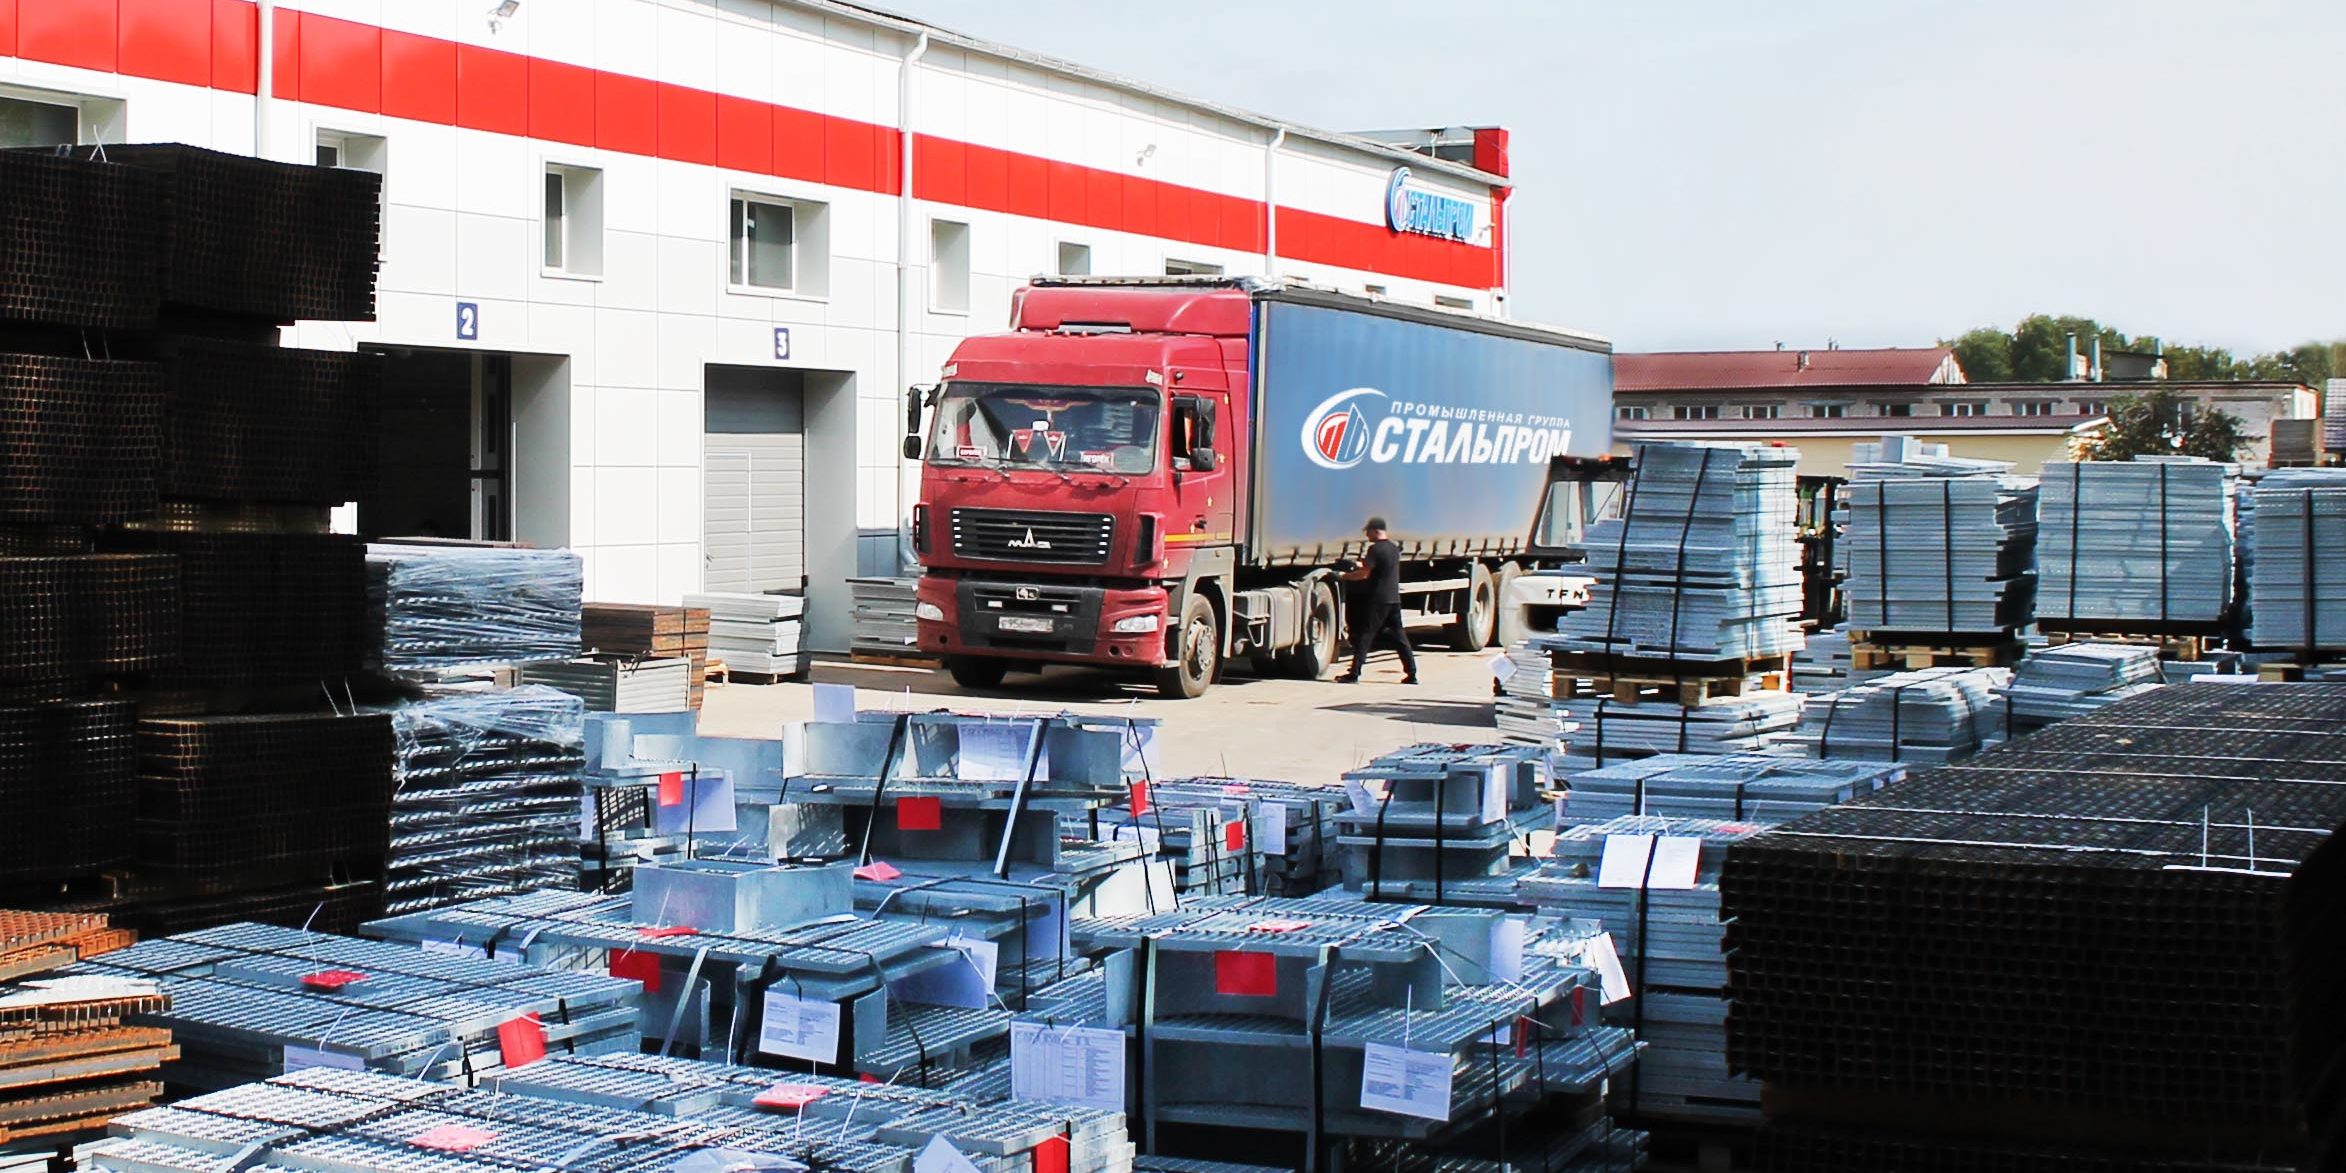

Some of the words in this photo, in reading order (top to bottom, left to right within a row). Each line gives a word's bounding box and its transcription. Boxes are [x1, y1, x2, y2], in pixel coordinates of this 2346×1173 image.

[461, 307, 474, 336] 2
[777, 331, 787, 357] 3
[1390, 401, 1523, 425] ПРОМЫШЛЕННАЯ
[1527, 414, 1571, 428] ГРУППА
[1370, 416, 1573, 464] СТАЛЬПРОМ
